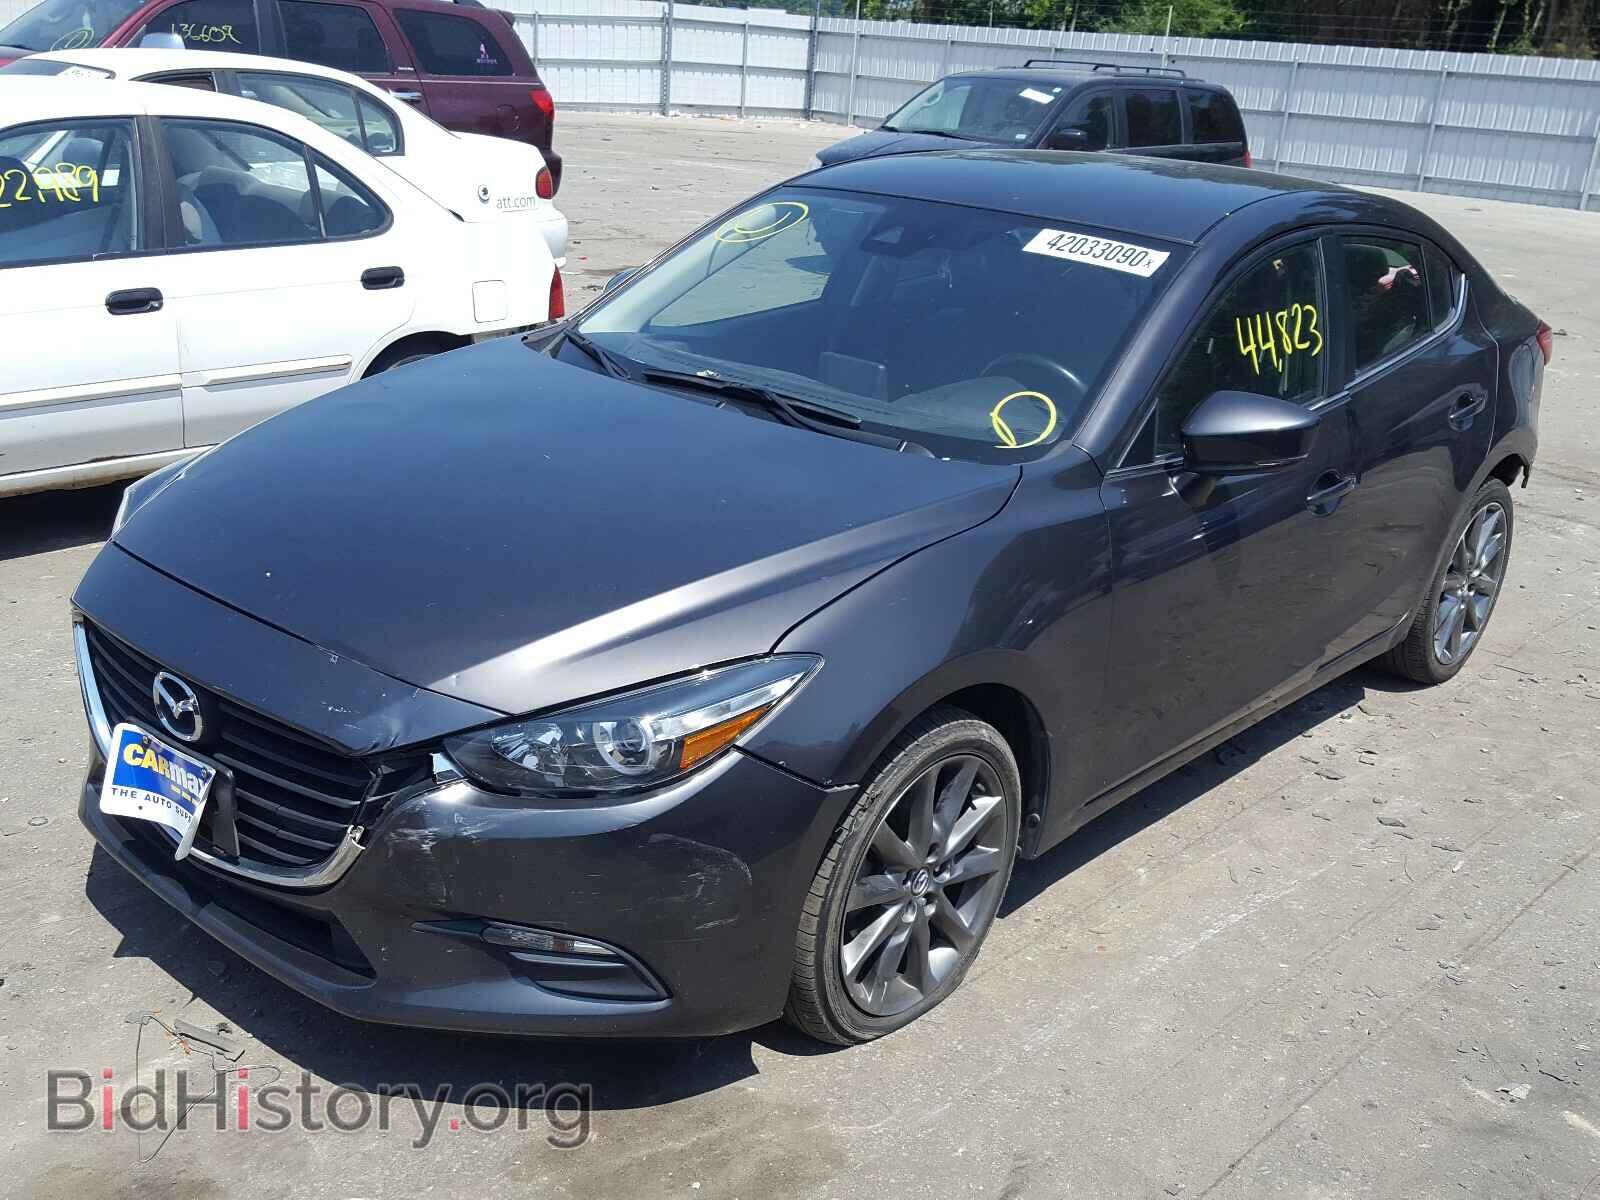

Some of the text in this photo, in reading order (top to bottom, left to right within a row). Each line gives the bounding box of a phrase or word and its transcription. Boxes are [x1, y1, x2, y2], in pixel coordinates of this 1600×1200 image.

[496, 196, 536, 209] att.com
[111, 787, 137, 799] THE
[144, 793, 172, 809] AUTO
